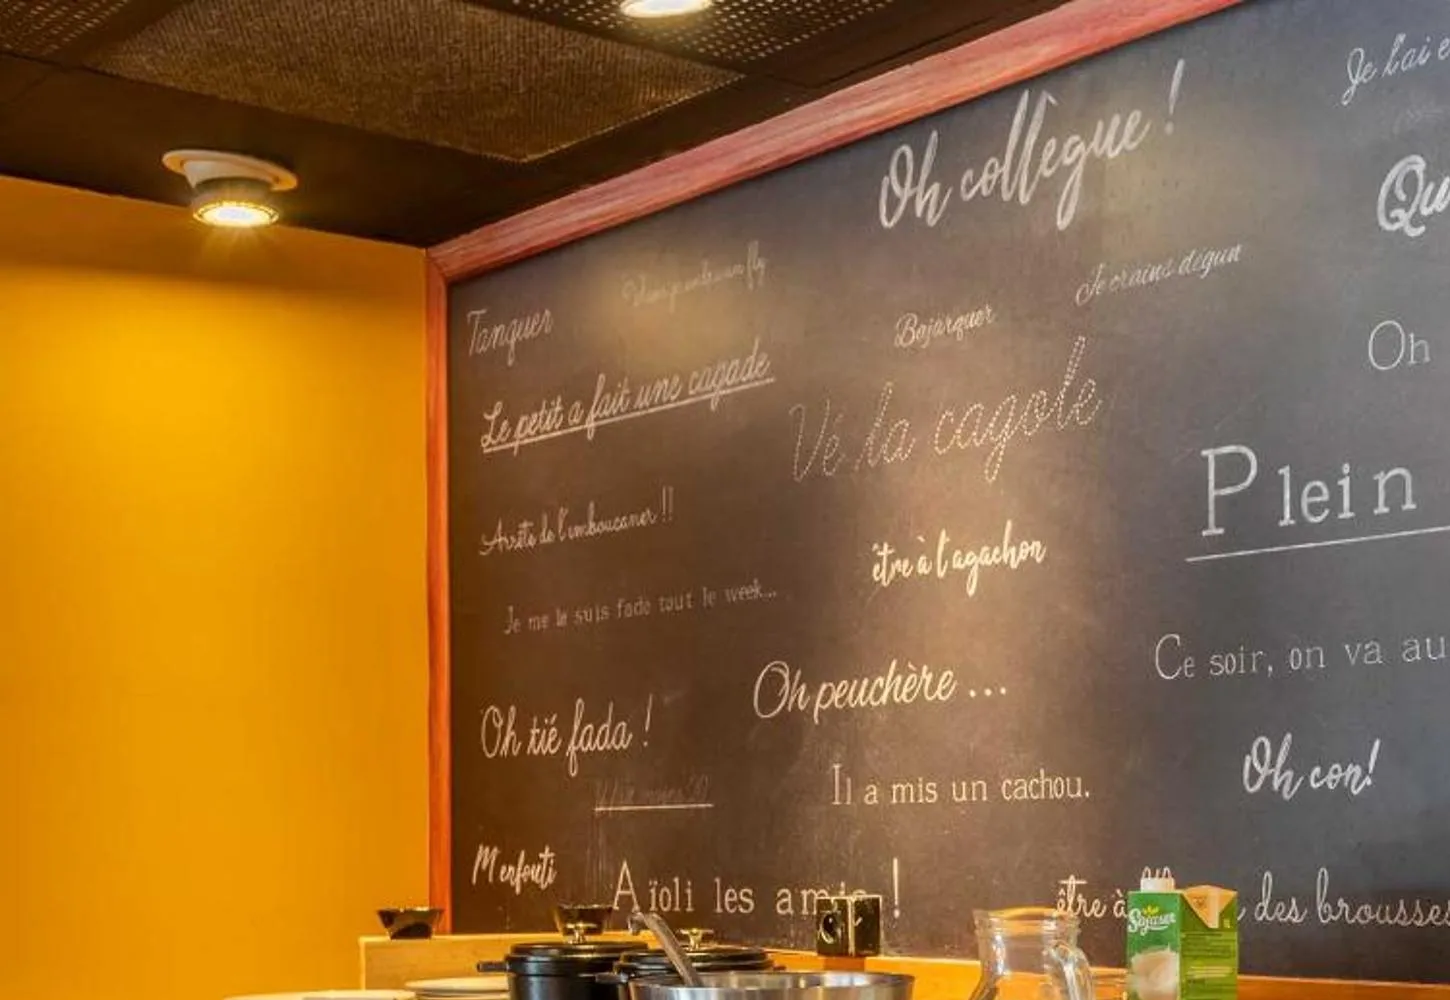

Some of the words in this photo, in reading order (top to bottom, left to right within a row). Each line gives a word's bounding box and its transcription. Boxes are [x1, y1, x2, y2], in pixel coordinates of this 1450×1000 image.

[1343, 47, 1377, 105] Je
[1383, 33, 1430, 77] l'ai
[879, 131, 953, 228] Oh
[1165, 59, 1185, 135] !
[1368, 320, 1431, 370] Oh
[481, 402, 511, 447] Le
[514, 396, 563, 456] petit
[567, 406, 584, 424] a
[586, 374, 630, 440] fait
[633, 375, 683, 409] une
[1200, 444, 1416, 537] Plein
[916, 535, 934, 576] à
[1154, 634, 1196, 681] Ce
[1209, 643, 1274, 678] soir,
[1289, 642, 1326, 672] on
[1344, 638, 1384, 666] va
[1402, 632, 1446, 663] au
[753, 660, 811, 719] Oh
[813, 658, 958, 724] peuchère
[480, 704, 521, 758] Oh
[527, 710, 563, 756] tié
[567, 698, 633, 777] fada
[643, 694, 655, 748] !
[1243, 733, 1302, 800] Oh
[831, 763, 851, 806] Il
[864, 781, 879, 804] a
[891, 777, 938, 805] mis
[952, 780, 988, 803] un
[1001, 768, 1090, 803] cachou.
[714, 877, 755, 915] les
[891, 857, 901, 918] !
[1255, 871, 1307, 922] des
